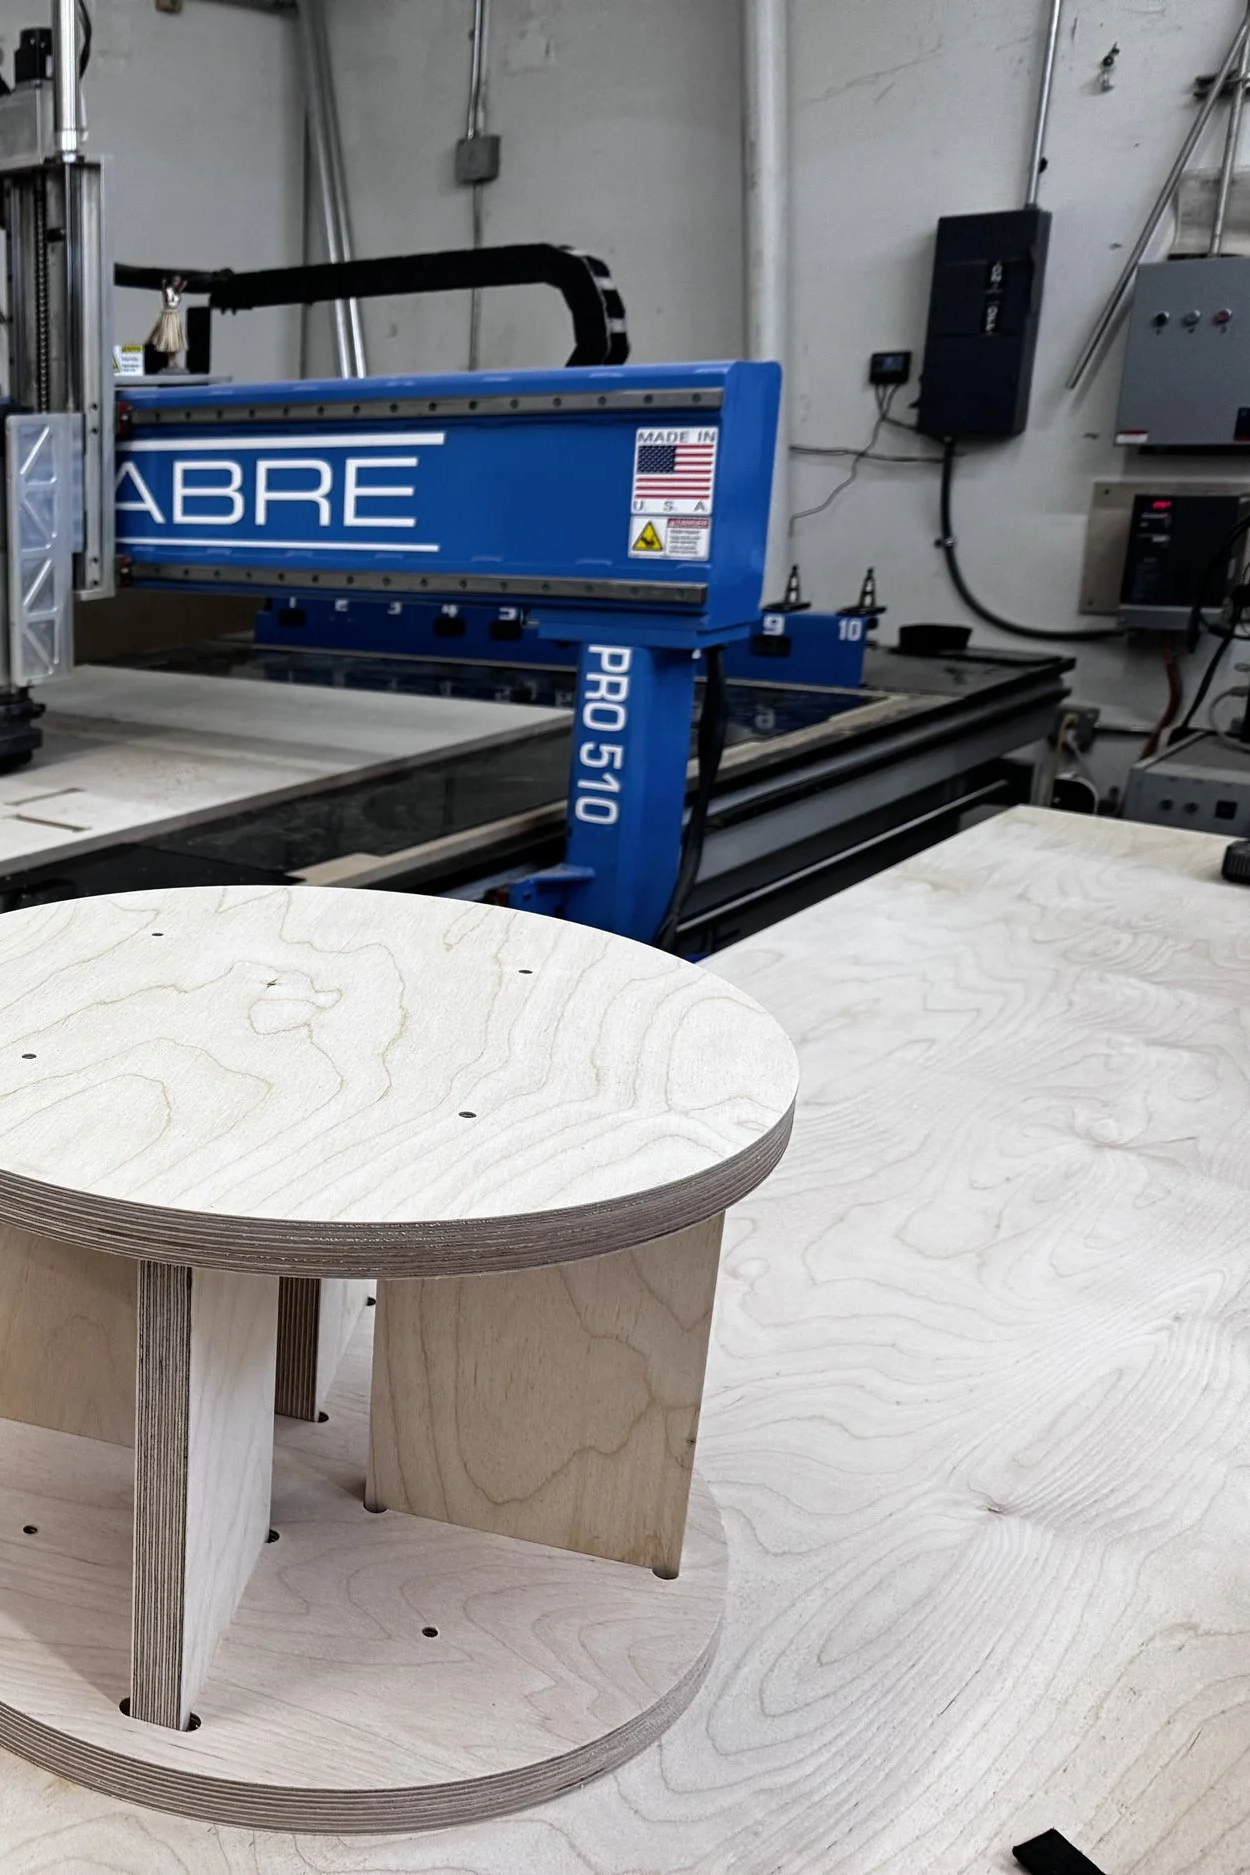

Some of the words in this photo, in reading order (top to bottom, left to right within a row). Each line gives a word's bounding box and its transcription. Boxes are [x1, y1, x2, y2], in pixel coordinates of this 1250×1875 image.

[636, 431, 690, 443] MADE
[697, 430, 716, 442] IN
[116, 457, 419, 528] ABRE
[763, 614, 785, 637] 9
[837, 618, 863, 642] 10
[583, 644, 631, 732] PRO
[575, 741, 623, 825] 510
